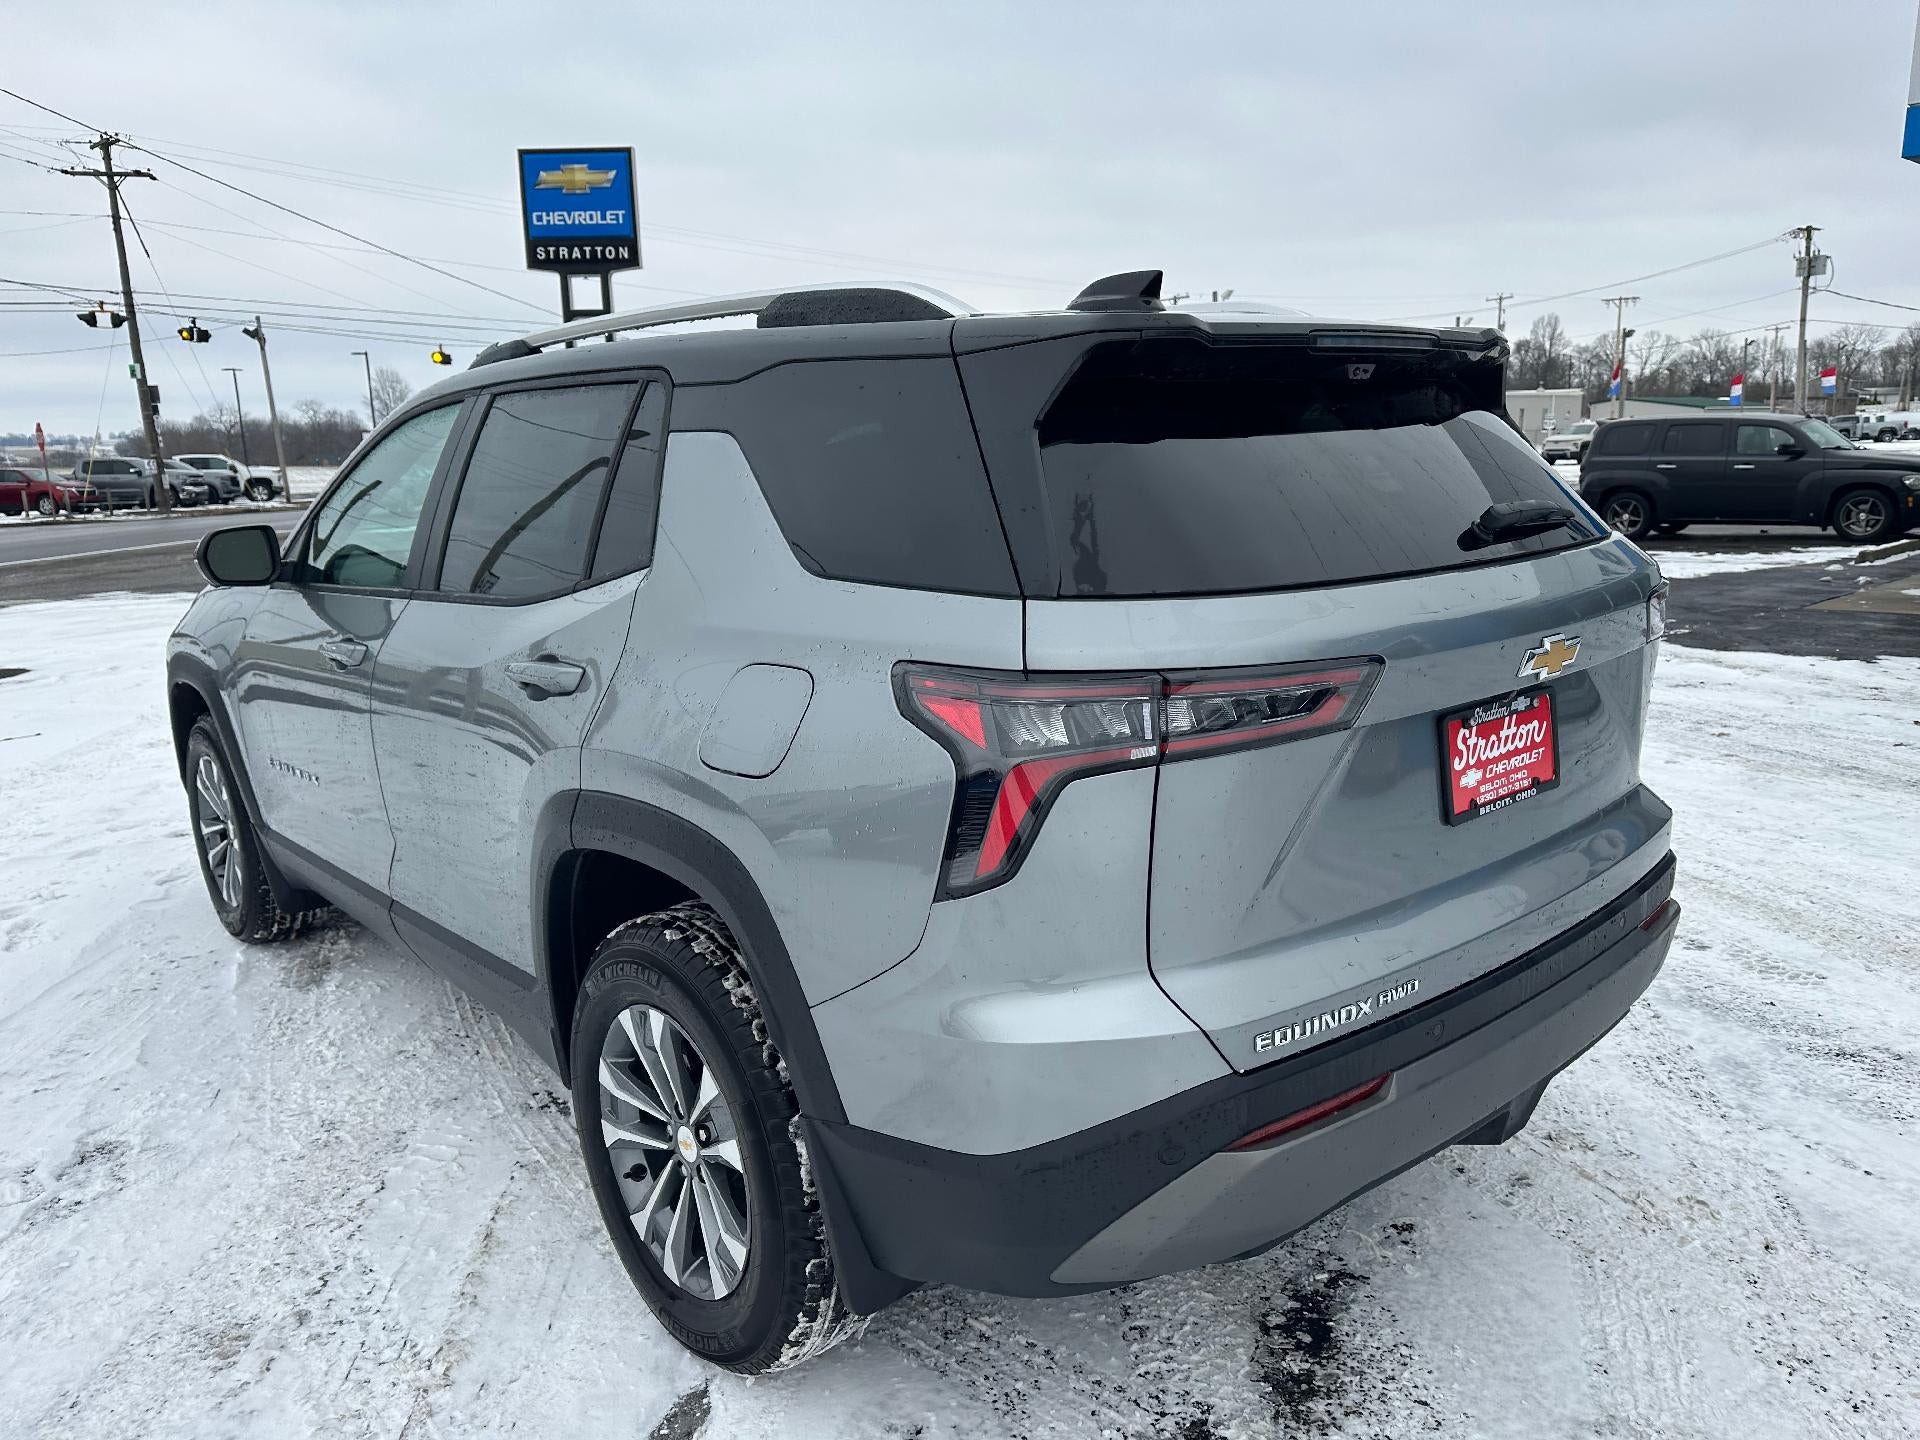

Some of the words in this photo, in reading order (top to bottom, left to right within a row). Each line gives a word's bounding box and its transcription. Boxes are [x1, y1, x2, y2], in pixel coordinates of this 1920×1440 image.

[532, 210, 626, 225] CHEVROLET
[536, 246, 629, 260] STRATTON
[1454, 714, 1547, 770] Stratton
[1486, 747, 1545, 778] CHEVROLET
[1515, 787, 1537, 801] OHIO
[604, 962, 660, 987] MICHELIN
[1255, 997, 1374, 1053] EQUINOX
[1378, 979, 1420, 1008] AWD
